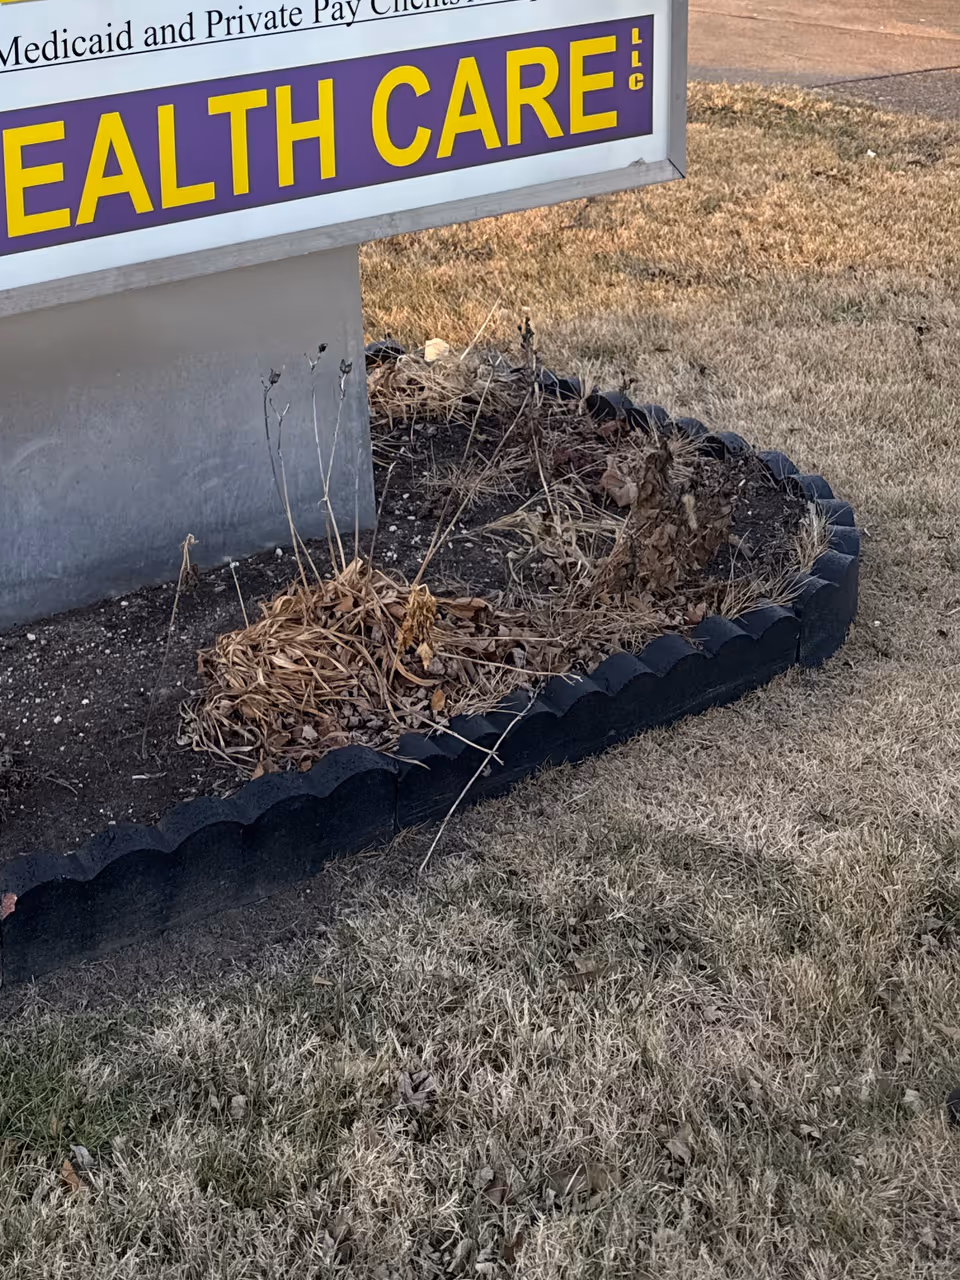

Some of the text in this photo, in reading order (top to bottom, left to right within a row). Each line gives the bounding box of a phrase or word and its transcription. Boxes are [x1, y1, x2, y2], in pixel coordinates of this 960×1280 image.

[143, 8, 196, 44] and
[205, 3, 304, 40] Private
[629, 27, 644, 91] LLC
[371, 35, 618, 168] CARE
